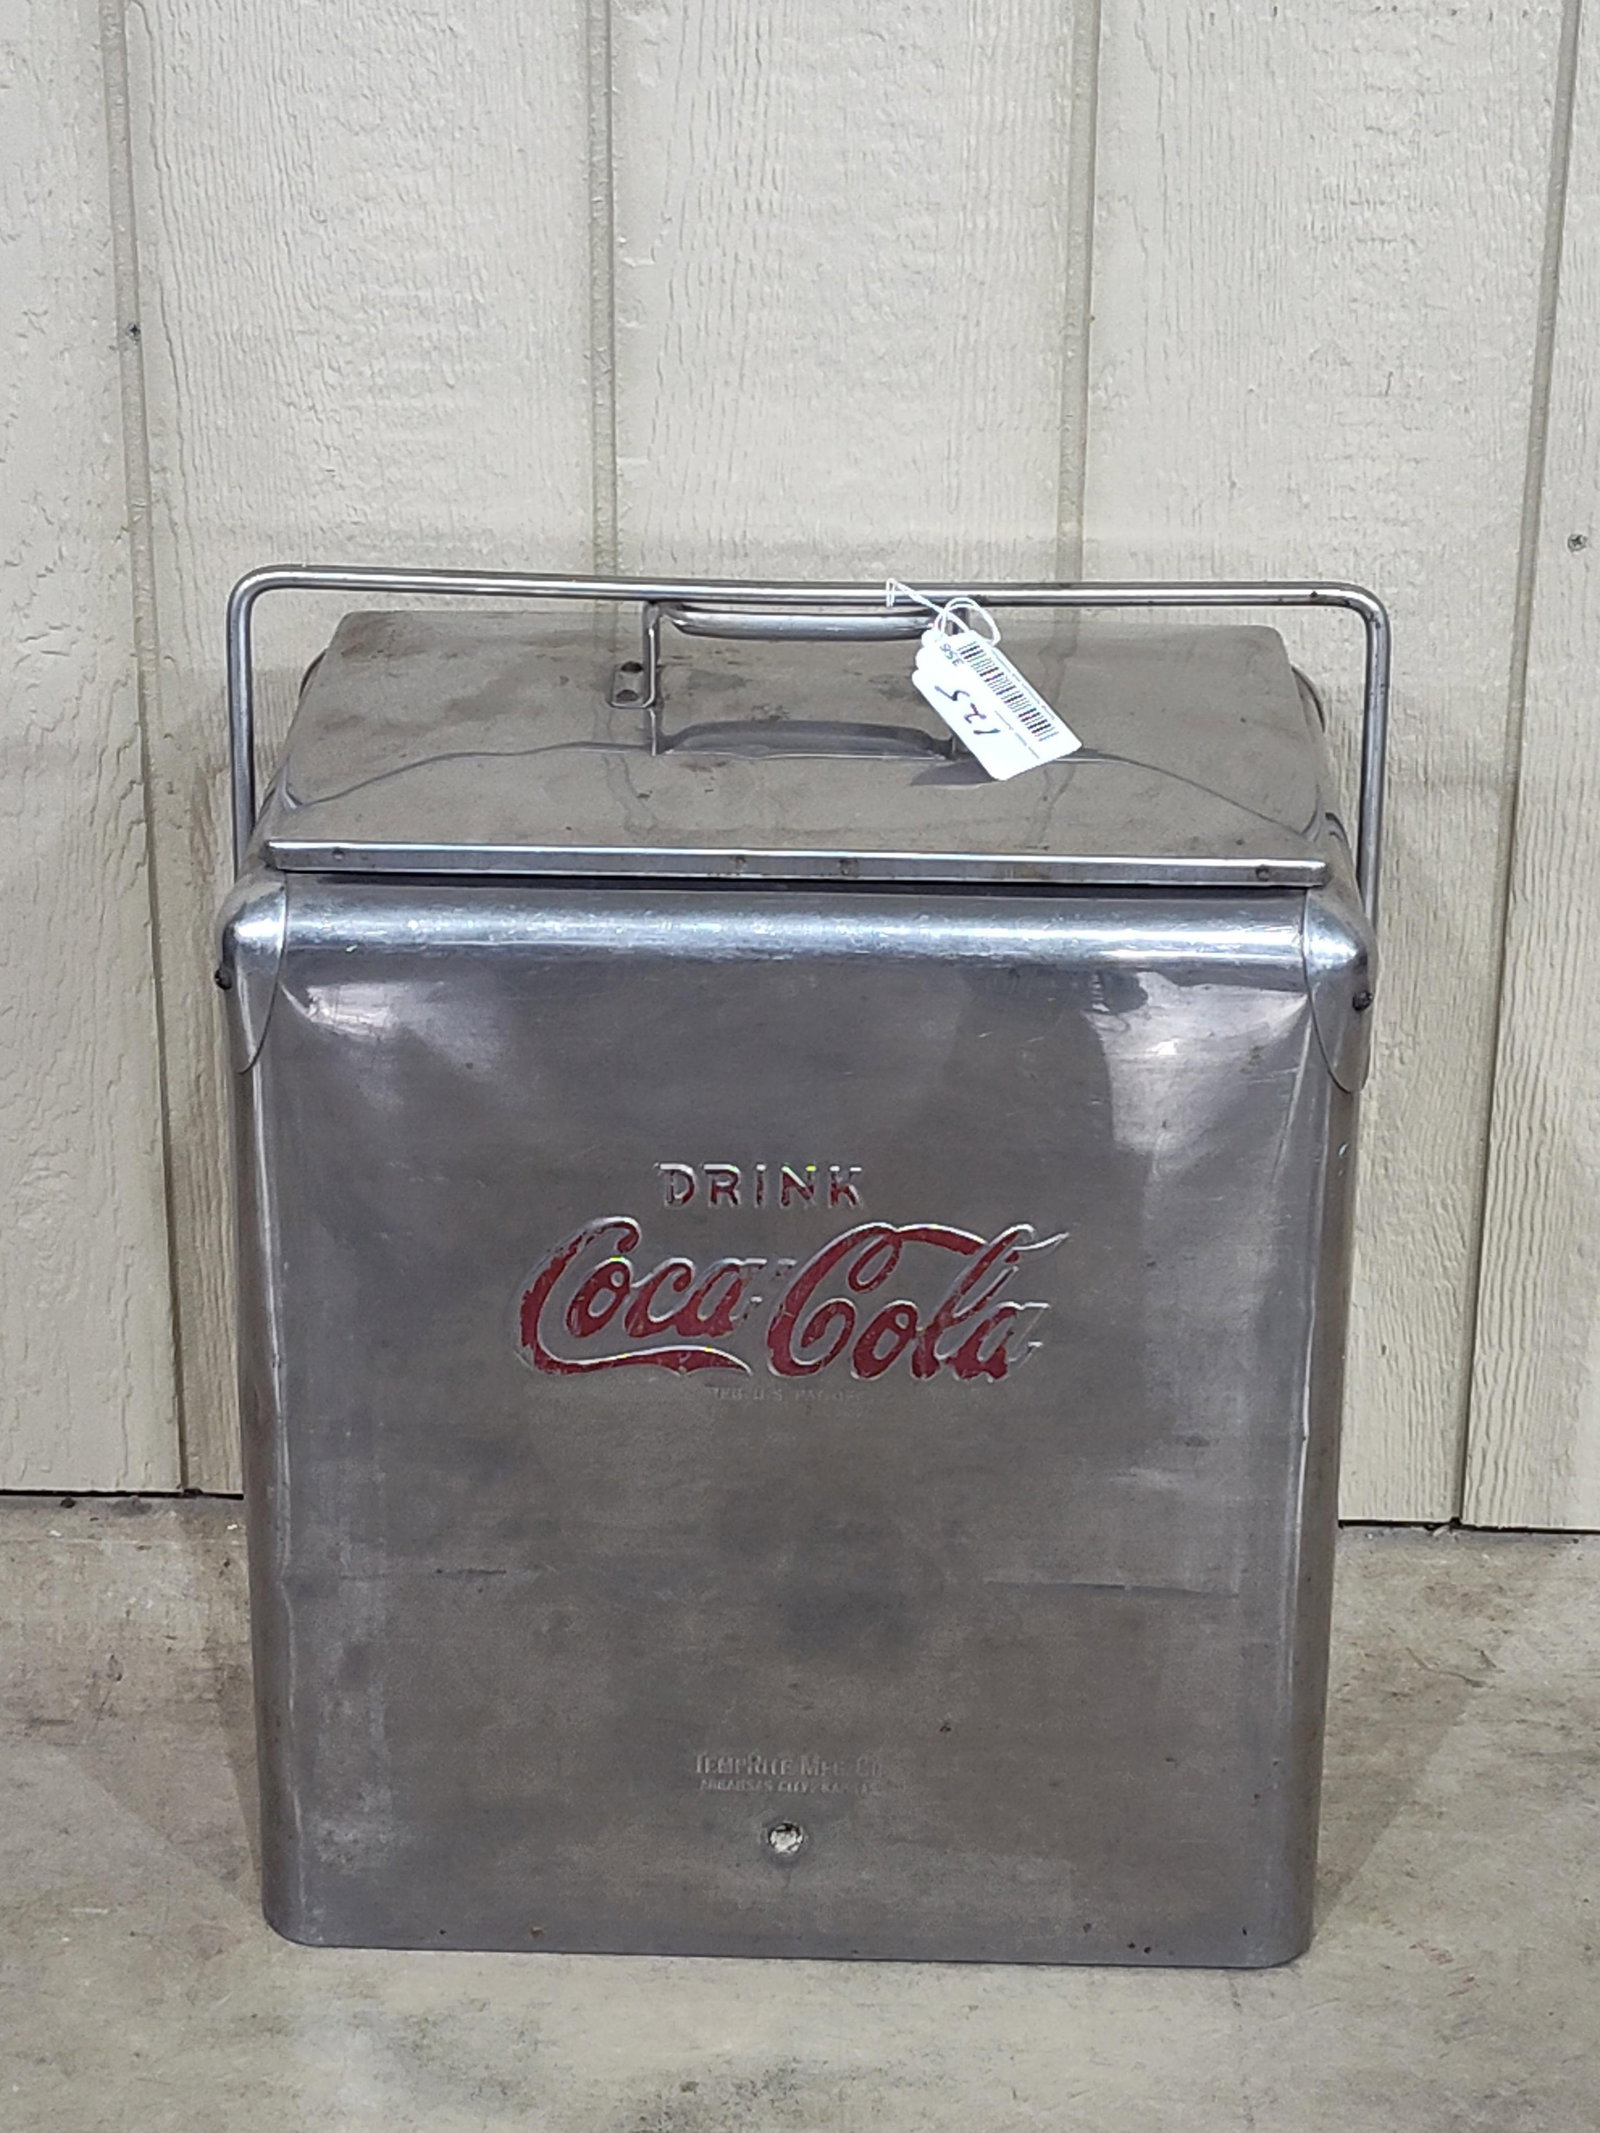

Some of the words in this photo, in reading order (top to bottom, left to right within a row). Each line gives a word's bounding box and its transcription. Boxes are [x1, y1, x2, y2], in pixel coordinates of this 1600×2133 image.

[933, 685, 1002, 735] 125
[656, 1163, 864, 1208] DRINK
[517, 1215, 1070, 1382] Coca-Cola
